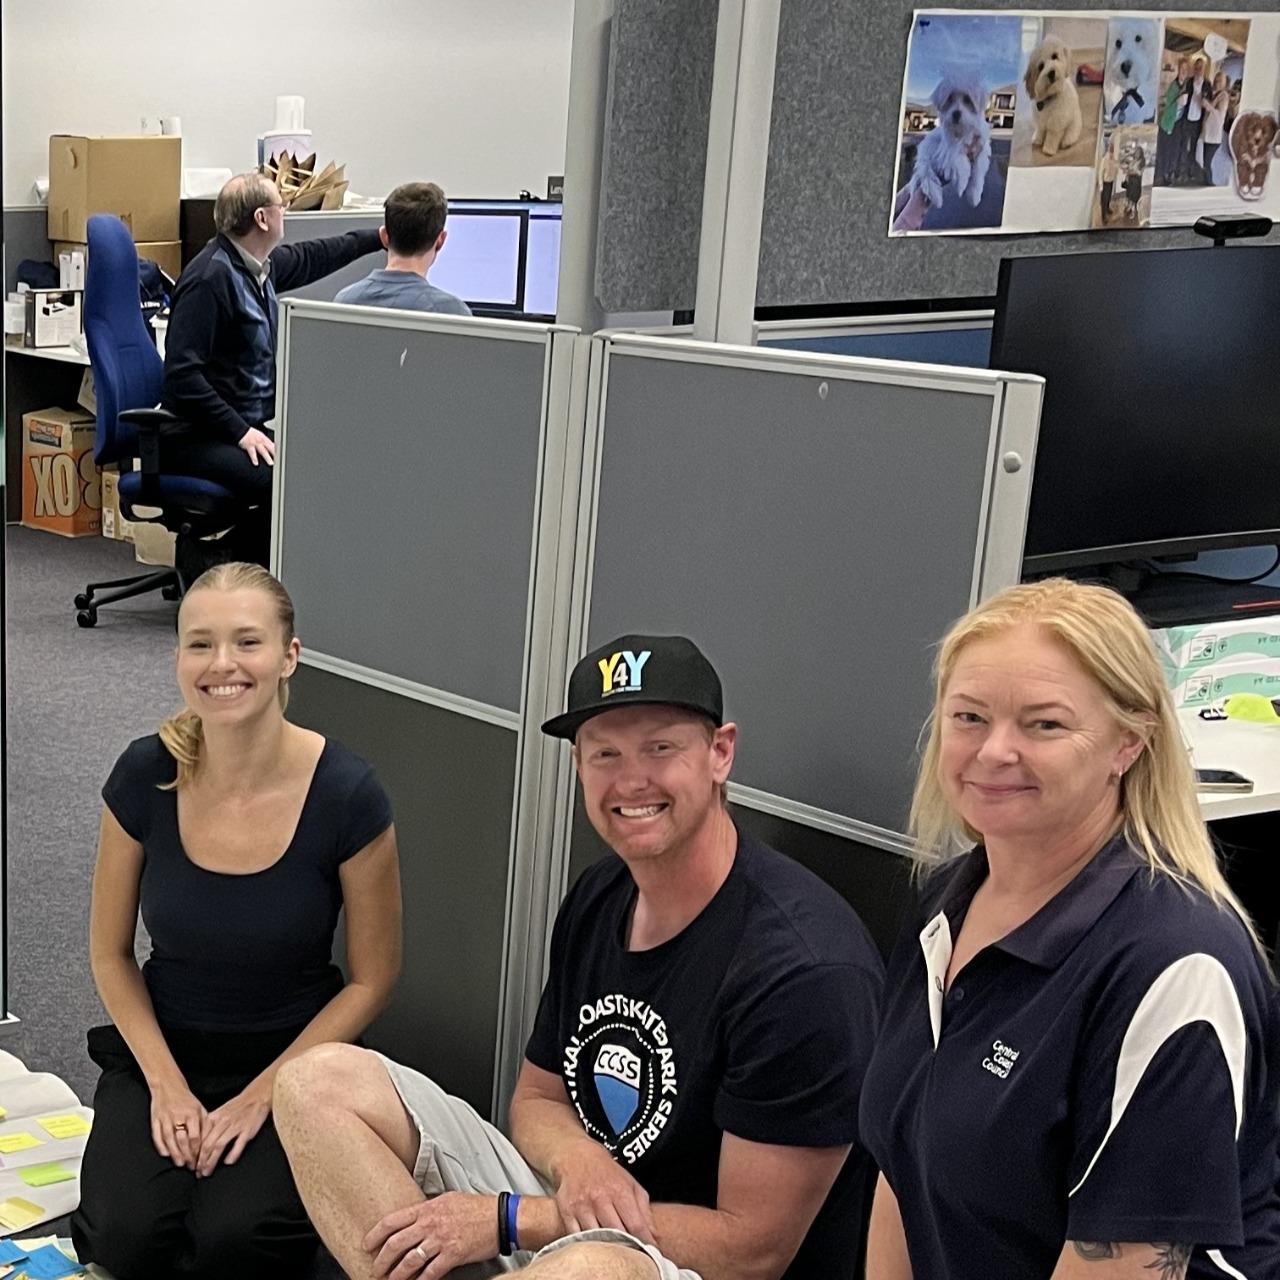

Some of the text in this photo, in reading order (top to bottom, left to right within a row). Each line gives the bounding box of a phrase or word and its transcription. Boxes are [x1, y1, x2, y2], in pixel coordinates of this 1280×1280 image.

[598, 650, 652, 692] Y4Y
[598, 1050, 639, 1080] CCSS
[622, 1098, 673, 1165] SERIES
